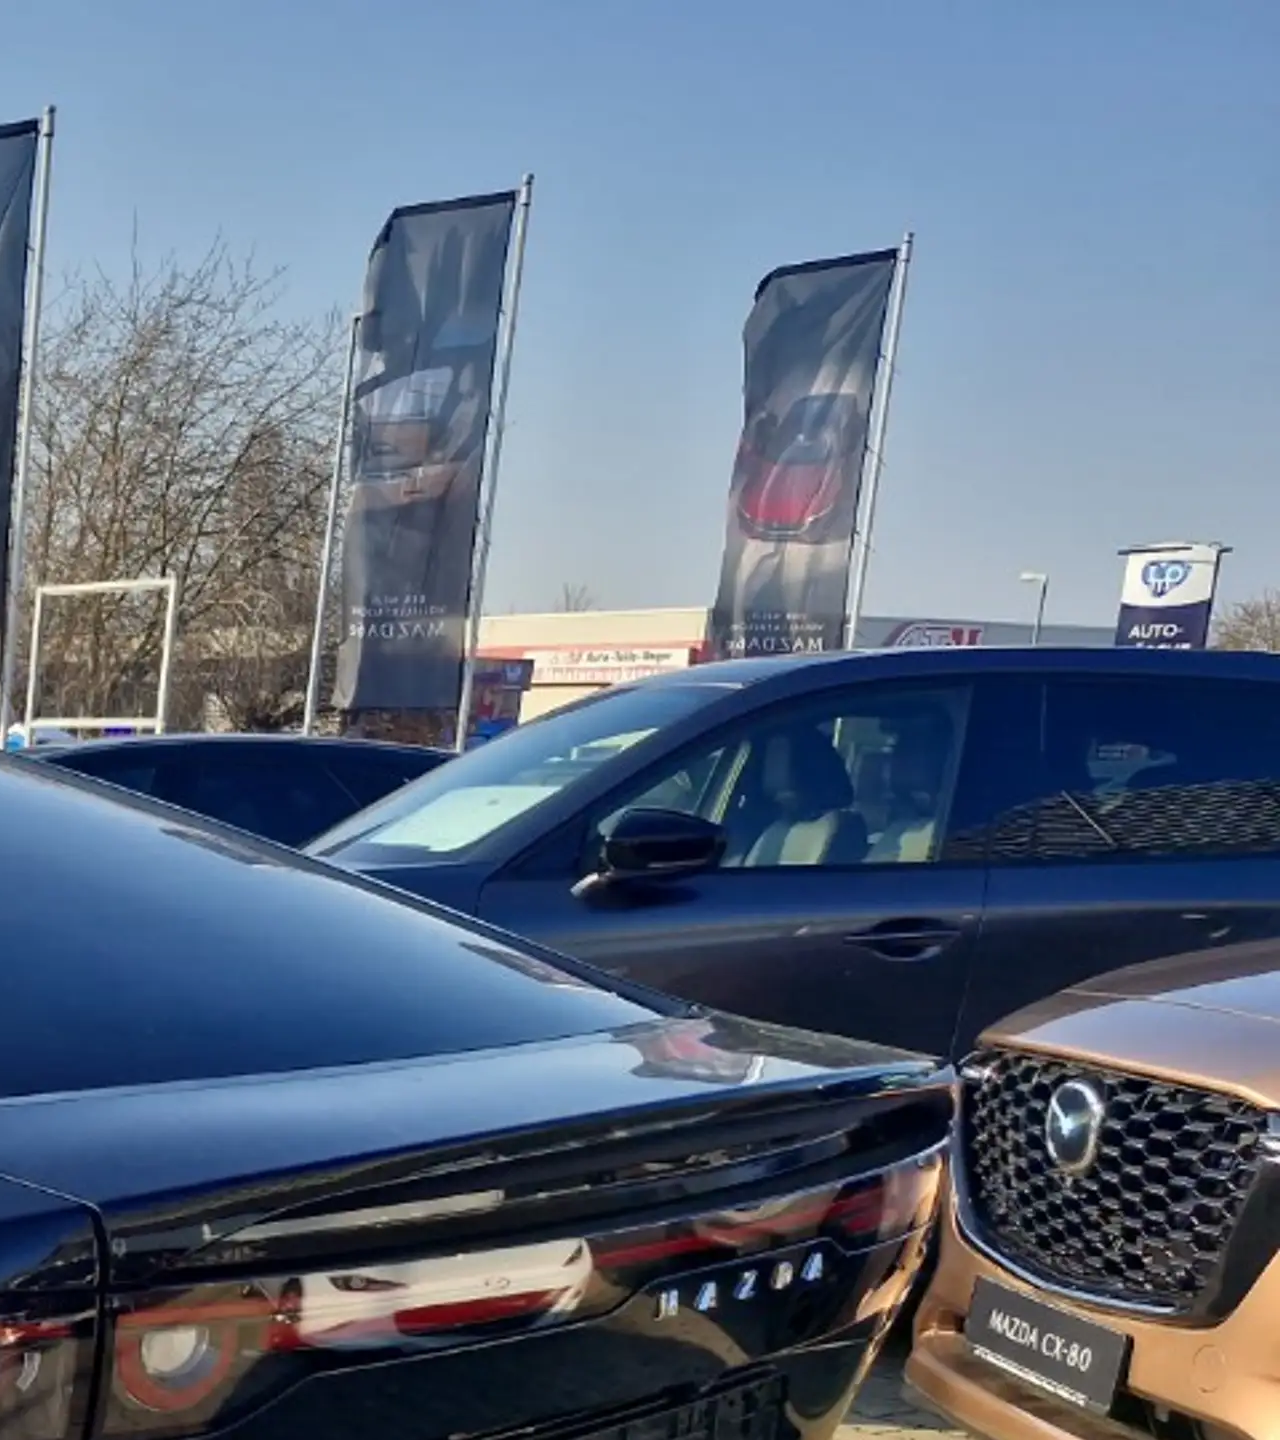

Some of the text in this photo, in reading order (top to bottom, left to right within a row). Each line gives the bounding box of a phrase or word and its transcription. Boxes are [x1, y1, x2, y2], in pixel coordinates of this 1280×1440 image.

[1128, 624, 1184, 640] AUTO-
[988, 1307, 1093, 1372] MAZDA CX-80
